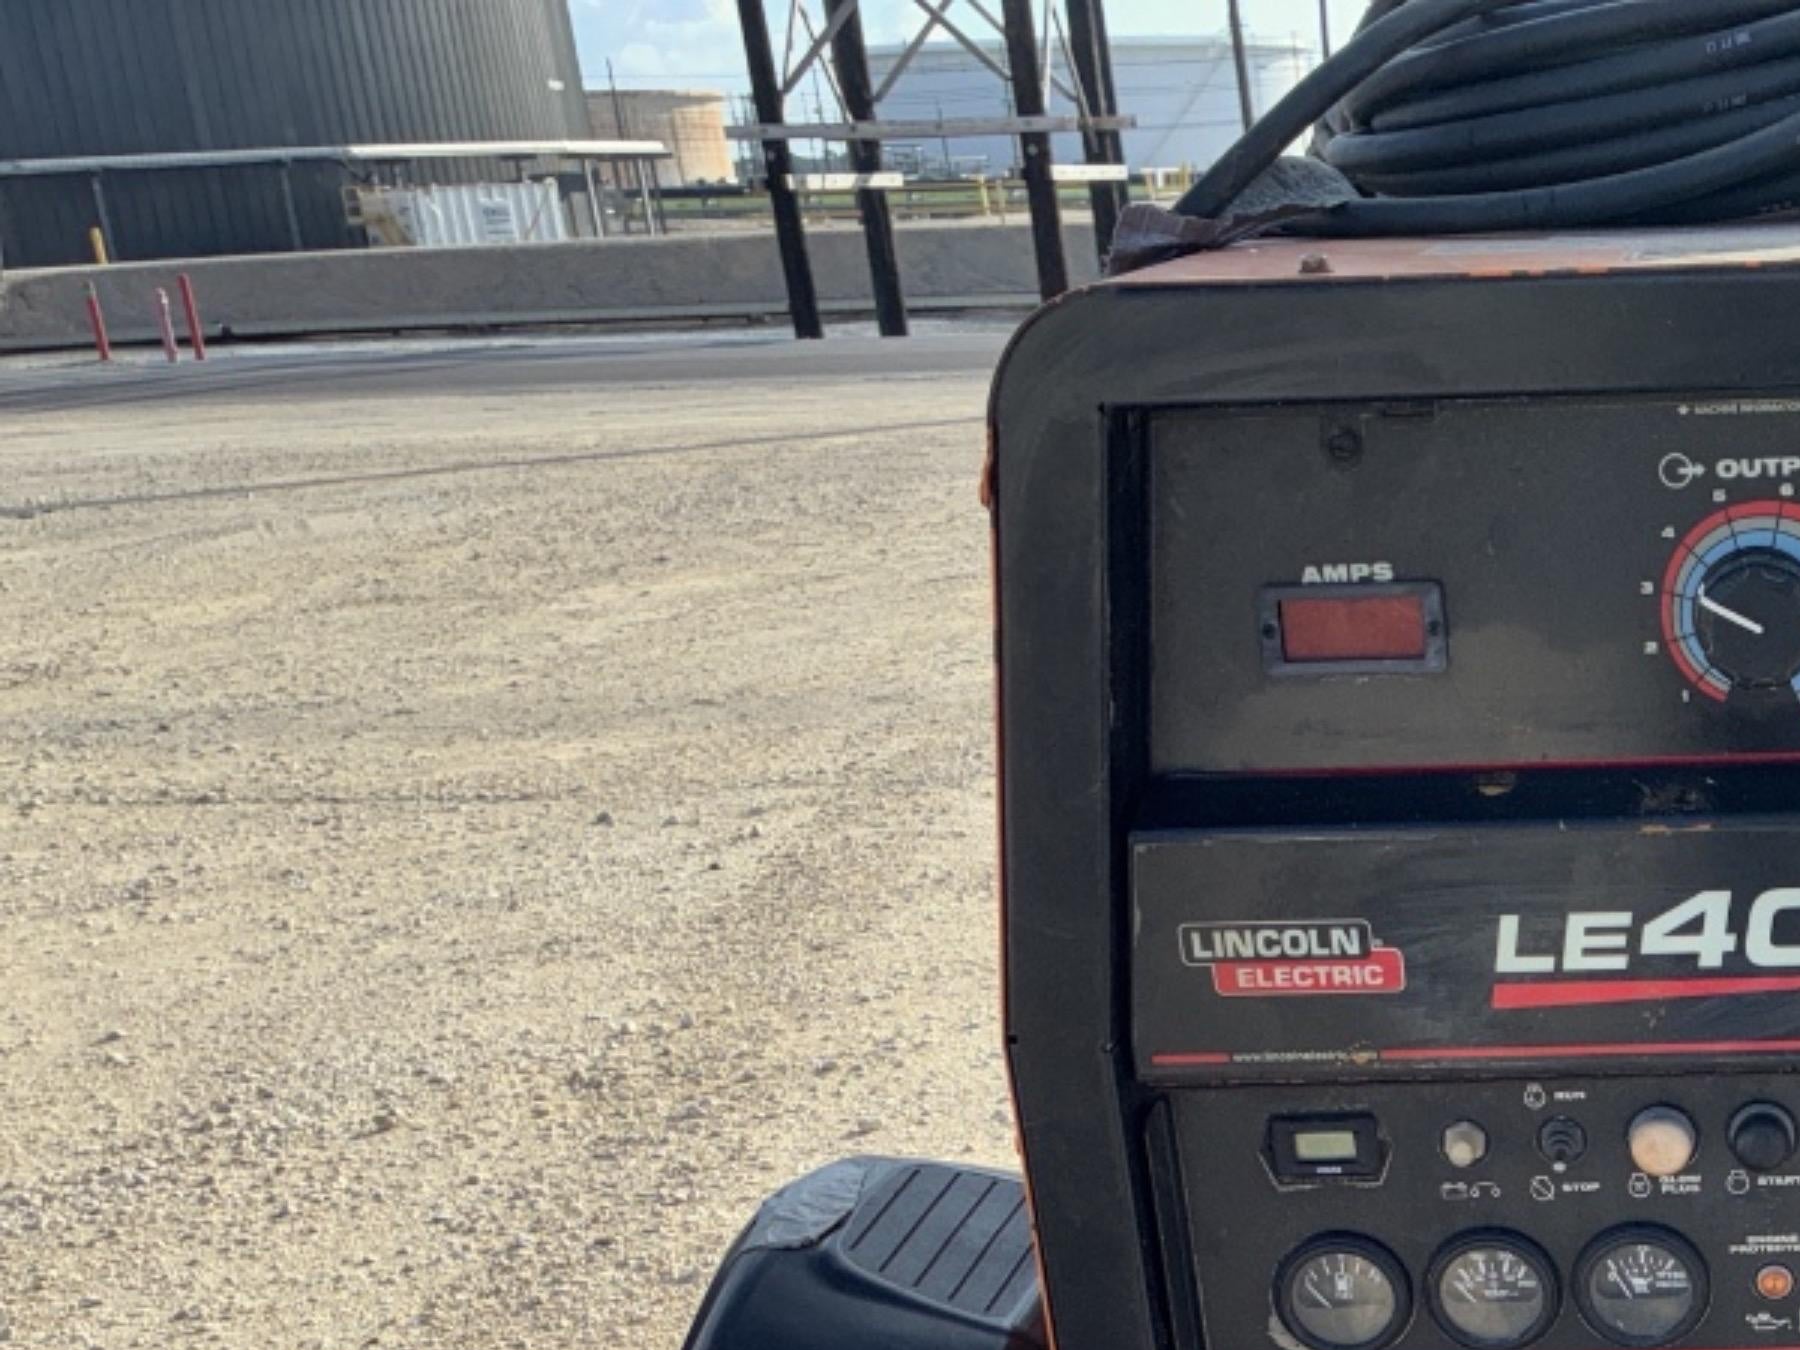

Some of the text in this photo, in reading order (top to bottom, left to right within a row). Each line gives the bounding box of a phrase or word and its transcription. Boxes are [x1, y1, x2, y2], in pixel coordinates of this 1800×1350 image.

[1301, 562, 1394, 584] AMPS
[1190, 926, 1361, 959] LINCOLN
[1236, 964, 1384, 989] ELECTRIC
